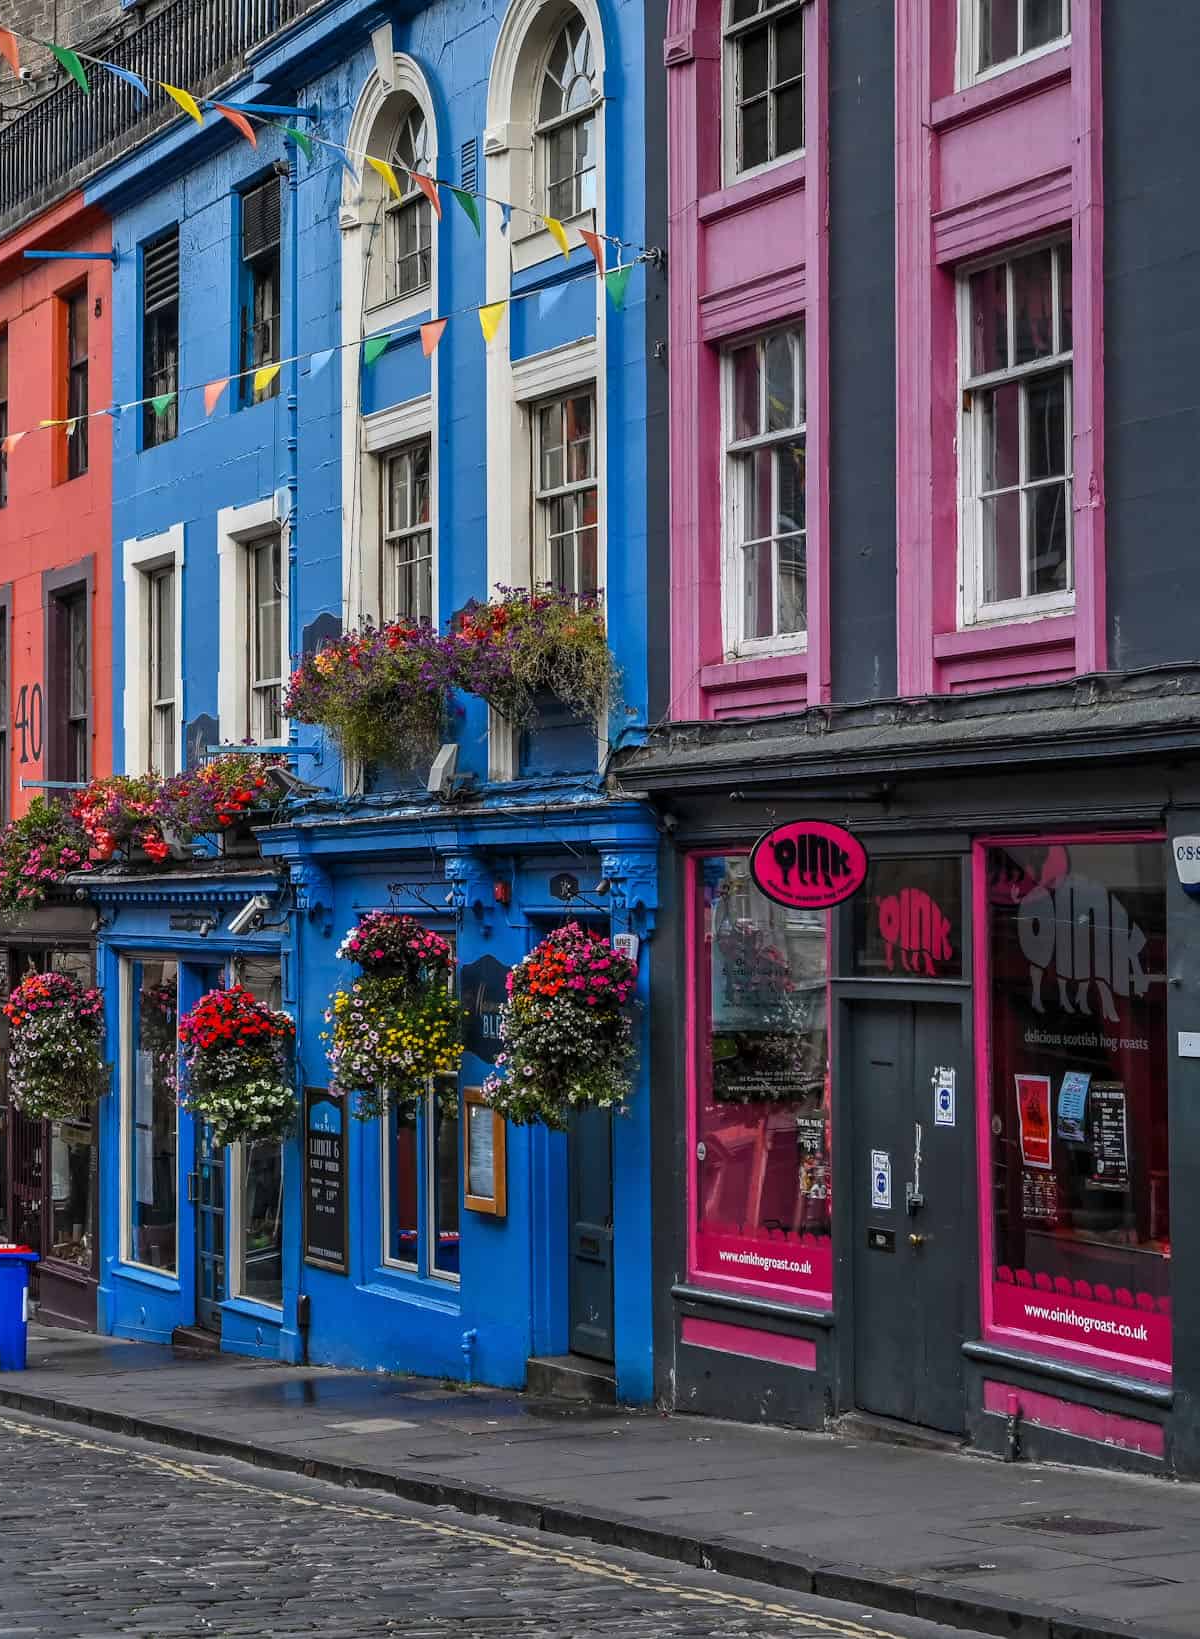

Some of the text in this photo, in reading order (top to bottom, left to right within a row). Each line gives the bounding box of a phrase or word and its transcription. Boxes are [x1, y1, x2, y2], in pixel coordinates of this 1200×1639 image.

[15, 682, 42, 763] 40
[1024, 1028, 1150, 1052] delicious scottish hog roasts
[719, 1250, 813, 1274] www.oinkhogroast.co.uk
[1024, 1304, 1148, 1341] www.oinkhogroast.co.uk
